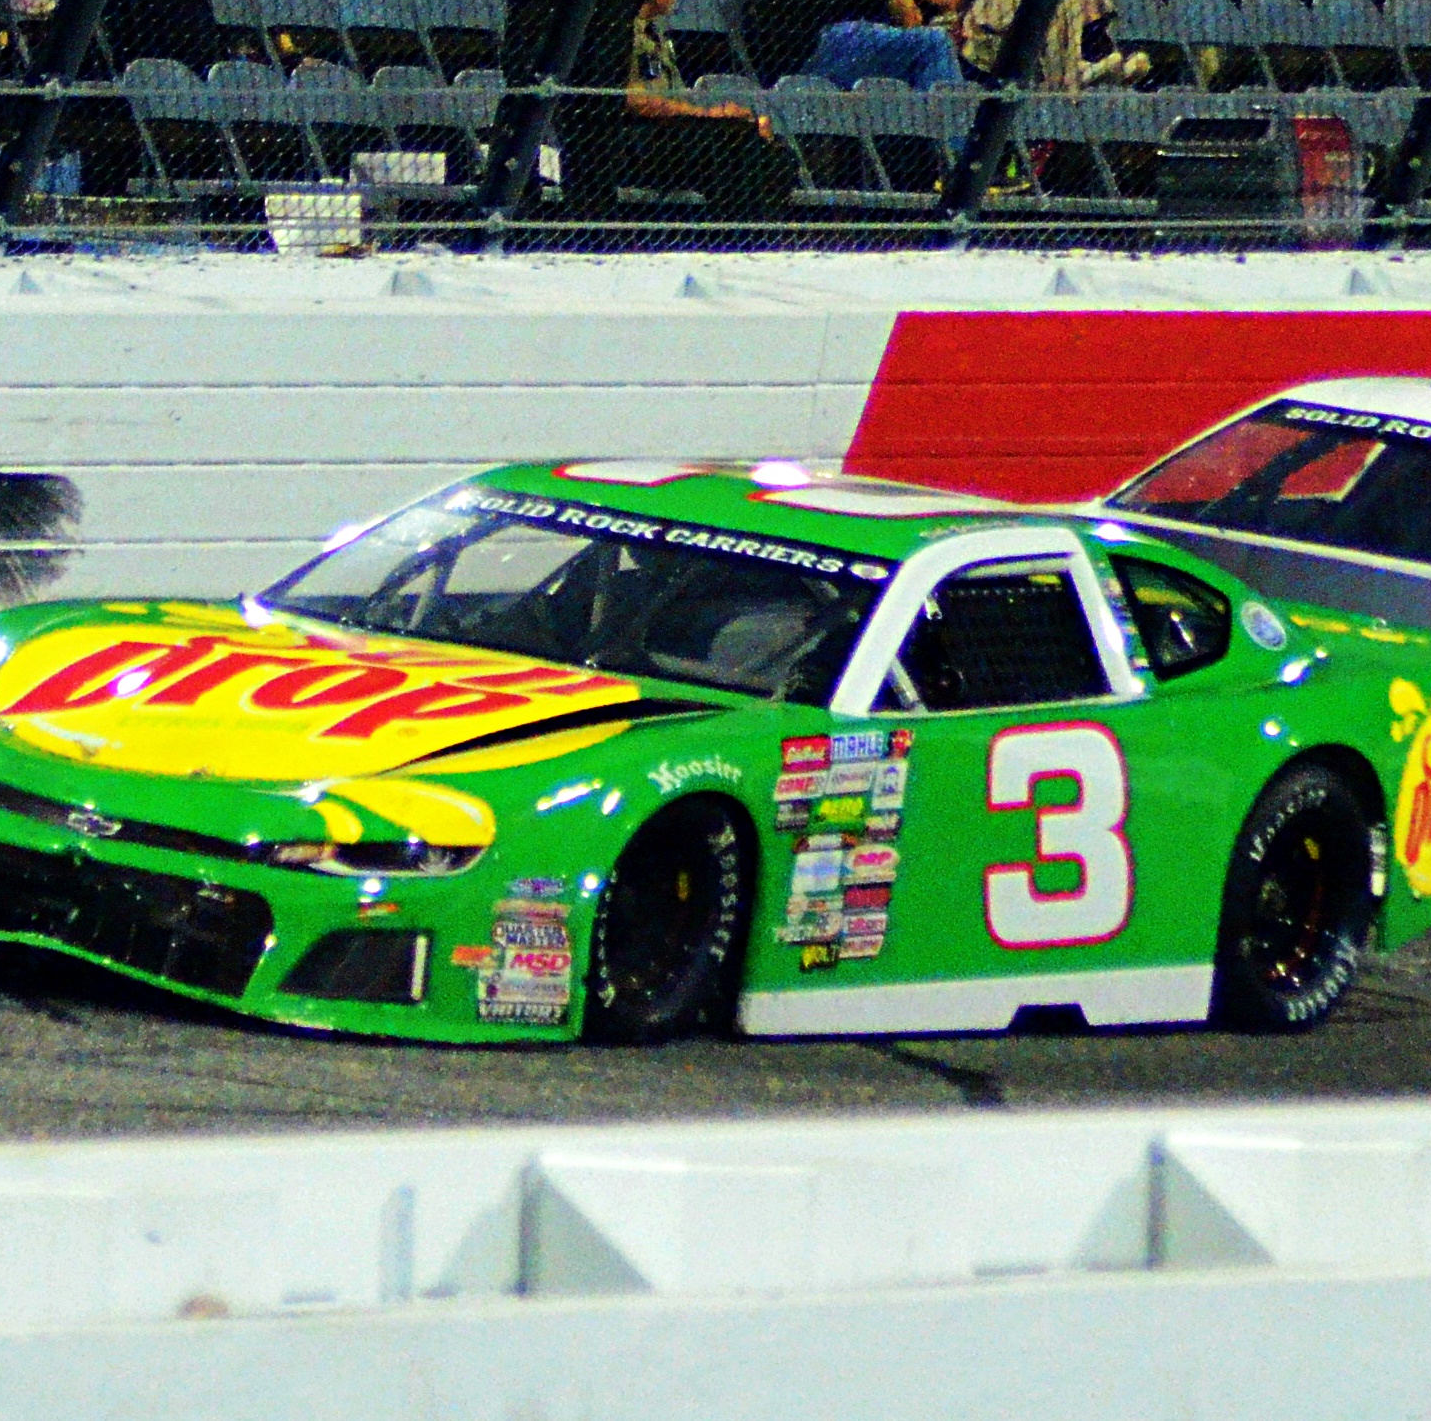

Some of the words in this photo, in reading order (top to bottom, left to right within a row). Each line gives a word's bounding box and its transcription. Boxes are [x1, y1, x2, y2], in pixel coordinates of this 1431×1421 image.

[1286, 406, 1380, 429] SOLID
[556, 505, 666, 541] ROCK
[664, 527, 845, 575] CARRIERS
[648, 754, 742, 795] Hoosier
[982, 719, 1135, 949] 3
